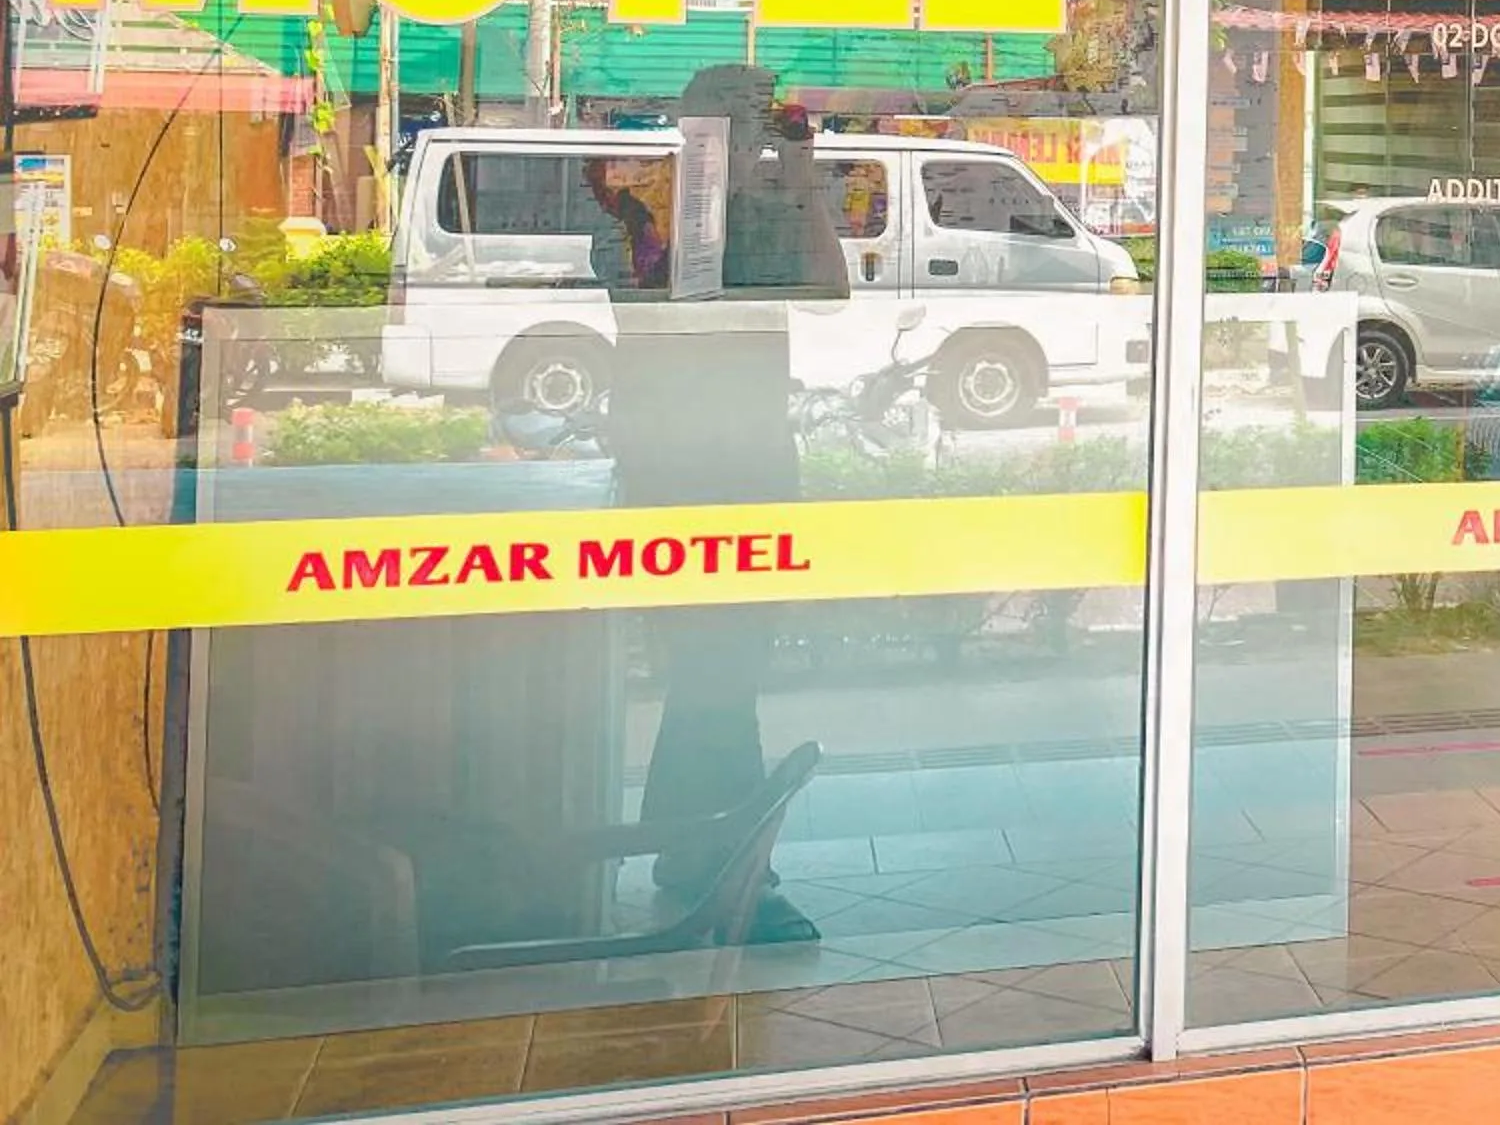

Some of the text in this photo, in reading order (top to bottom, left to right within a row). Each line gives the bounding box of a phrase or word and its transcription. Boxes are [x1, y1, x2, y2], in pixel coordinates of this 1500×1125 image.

[1433, 23, 1464, 48] 02
[286, 533, 811, 592] AMZAR MOTEL
